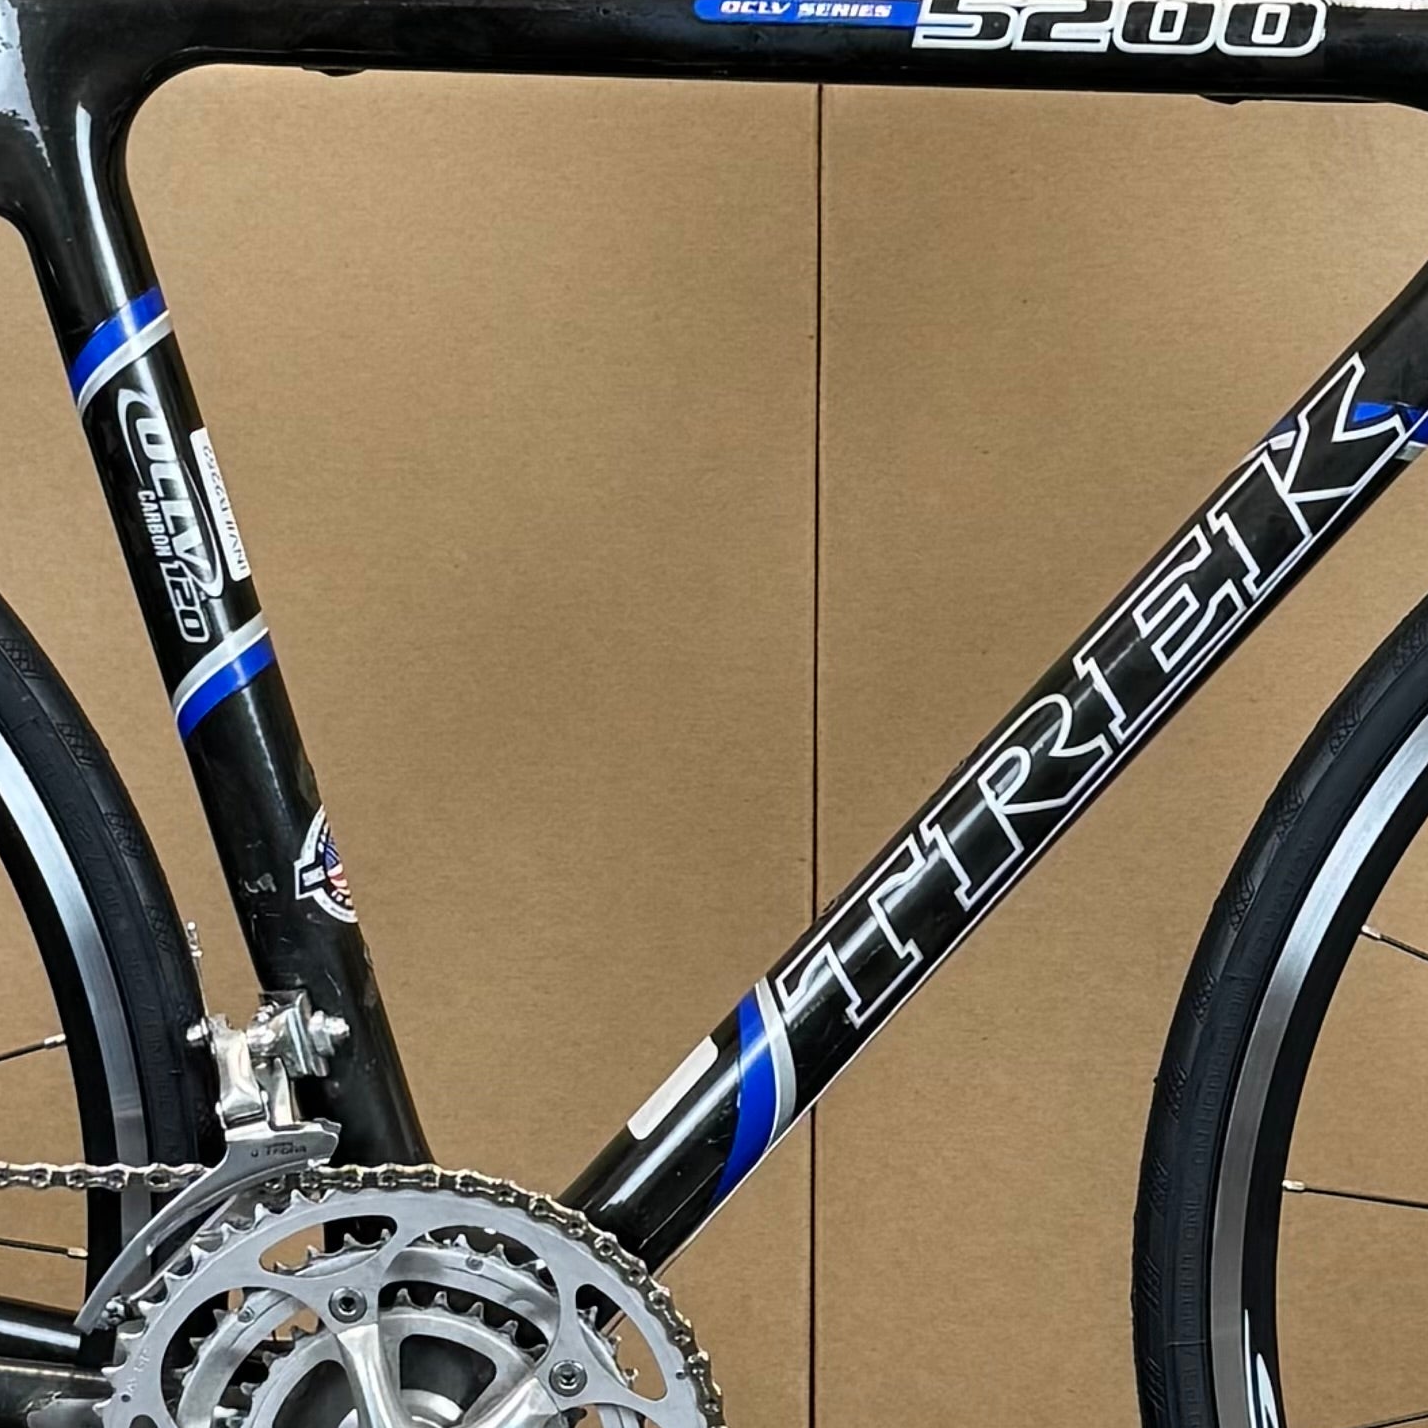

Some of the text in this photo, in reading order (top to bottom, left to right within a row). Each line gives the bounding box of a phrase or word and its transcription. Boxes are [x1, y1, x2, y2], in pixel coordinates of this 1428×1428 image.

[720, 0, 791, 17] OCLV
[797, 2, 892, 19] SERIES
[138, 489, 210, 644] CARBON 120
[775, 352, 1410, 1030] TREK
